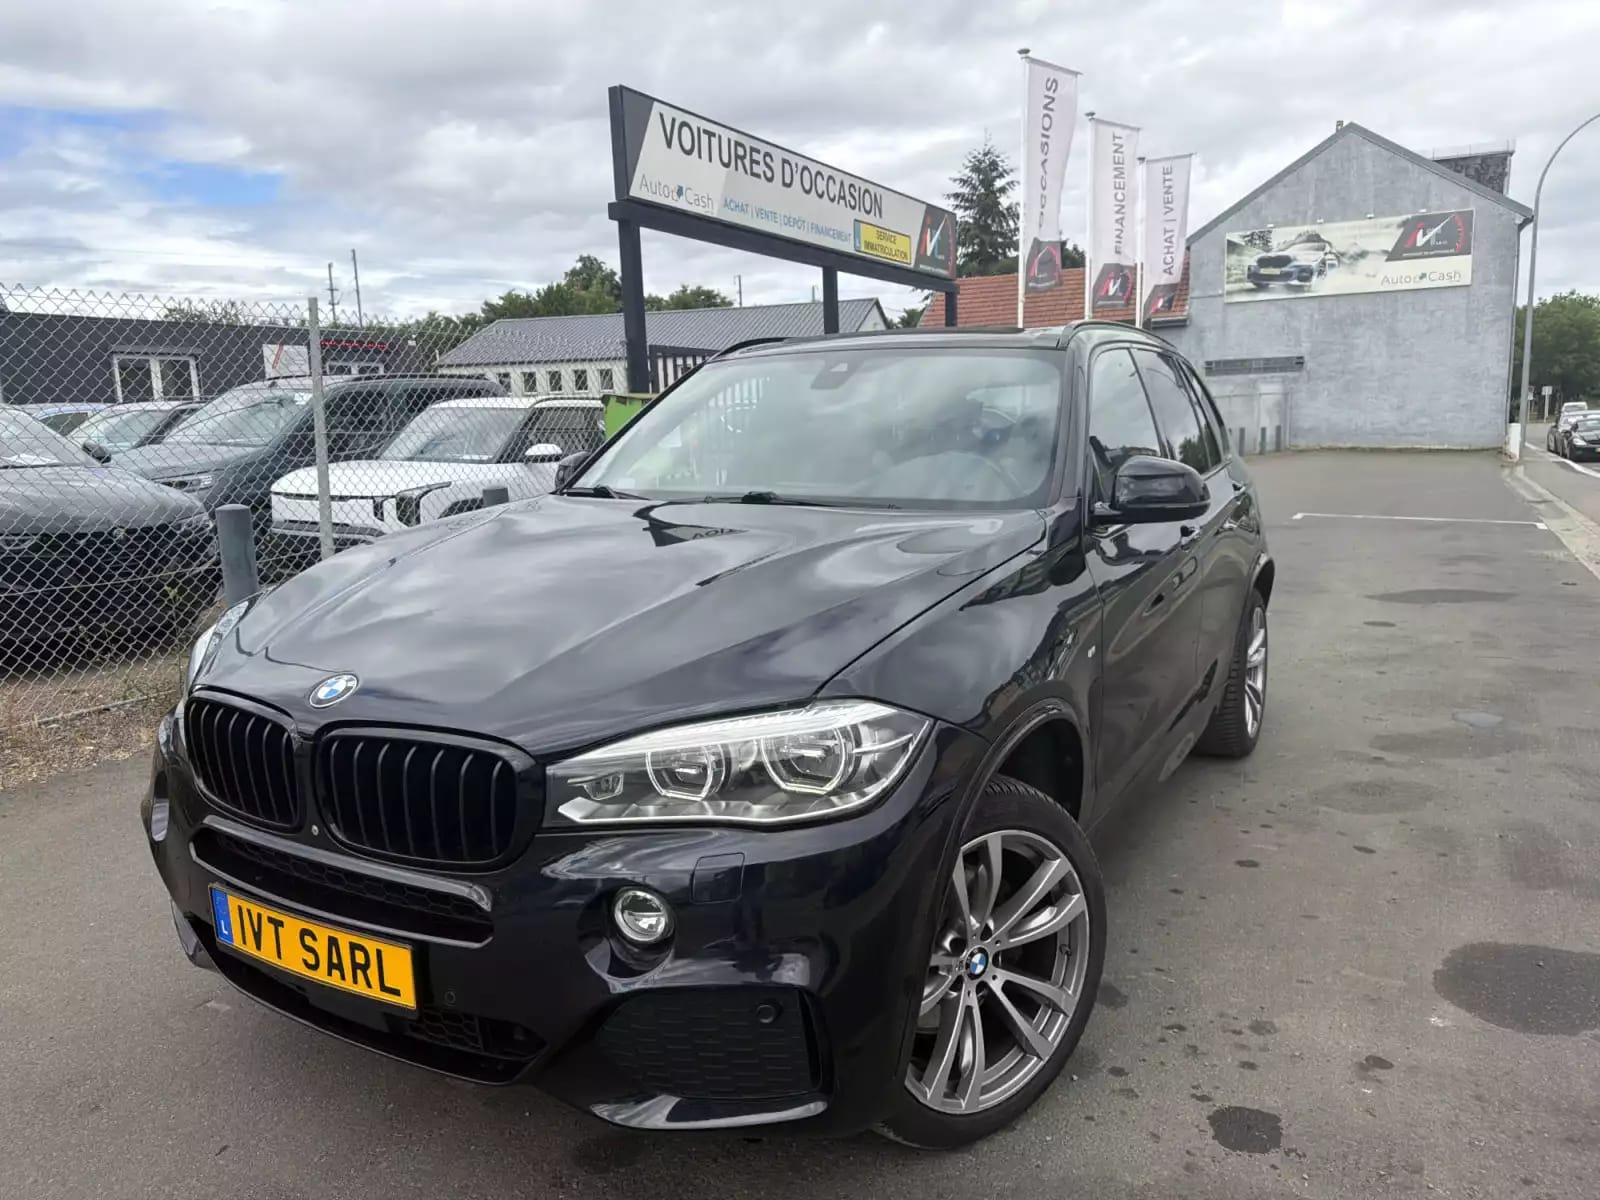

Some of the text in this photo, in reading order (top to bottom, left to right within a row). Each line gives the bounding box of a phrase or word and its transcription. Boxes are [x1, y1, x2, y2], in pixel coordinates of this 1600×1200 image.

[659, 112, 775, 183] VOITURES
[723, 197, 749, 214] ACHAT
[755, 207, 779, 224] VENTE
[1112, 132, 1126, 256] FINANCEMENT
[876, 230, 897, 244] SERVICE
[1163, 165, 1175, 276] ACHAT VENTE
[863, 240, 908, 260] IMMATRICULATION
[221, 920, 229, 935] L
[237, 905, 401, 997] IVT SARL
